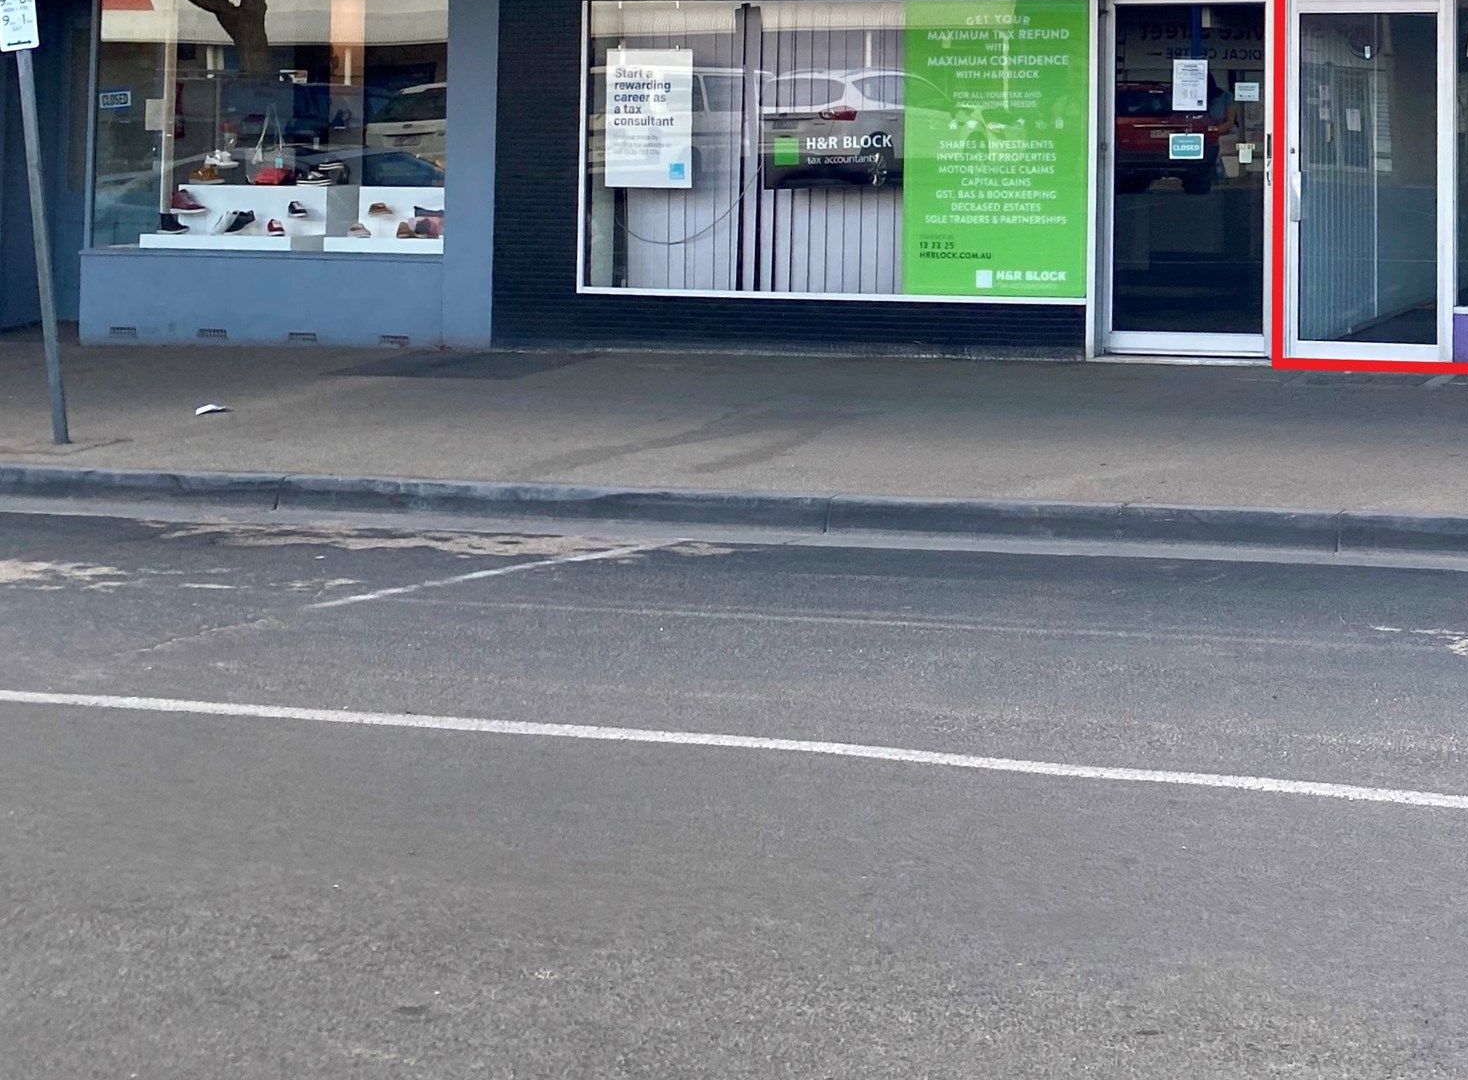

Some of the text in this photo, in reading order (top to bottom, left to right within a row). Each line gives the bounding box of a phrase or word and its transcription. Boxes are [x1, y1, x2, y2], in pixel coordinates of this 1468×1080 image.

[967, 15, 1031, 25] GET YOUR
[927, 30, 989, 40] MAXIMUM
[1018, 29, 1070, 40] REFUND
[985, 43, 1010, 52] WITH
[927, 55, 1069, 67] MAXIMUM CONFIDENCE
[615, 68, 653, 79] Start a
[955, 70, 981, 79] WITH
[1006, 70, 1040, 79] BLOCK
[614, 80, 672, 93] rewarding
[614, 93, 667, 103] career as
[953, 91, 970, 99] FOR
[1024, 91, 1042, 99] AND
[614, 104, 642, 114] a tax
[614, 115, 675, 127] consultant
[806, 135, 893, 150] H&R BLOCK
[939, 139, 1054, 149] SHARES & INVESTMENTS
[807, 154, 877, 165] tax accountants
[936, 152, 1057, 162] INVESTMENT PROPERTIES
[938, 165, 1055, 174] MOTOR VEHICLE CLAIMS
[961, 178, 1032, 187] CAPITAL GAINS
[958, 190, 976, 199] BAS
[978, 190, 985, 199] &
[986, 190, 1057, 199] BOOKKEEPING
[951, 203, 1042, 212] DECEASED ESTATES
[925, 215, 948, 224] SOLE
[949, 215, 990, 225] TRADERS
[1000, 215, 1067, 225] PARTNERSHIPS
[919, 242, 928, 250] 13
[944, 242, 955, 250] 25
[919, 252, 992, 260] HRBLOCK.COM.AU
[996, 270, 1067, 281] H&R BLOCK
